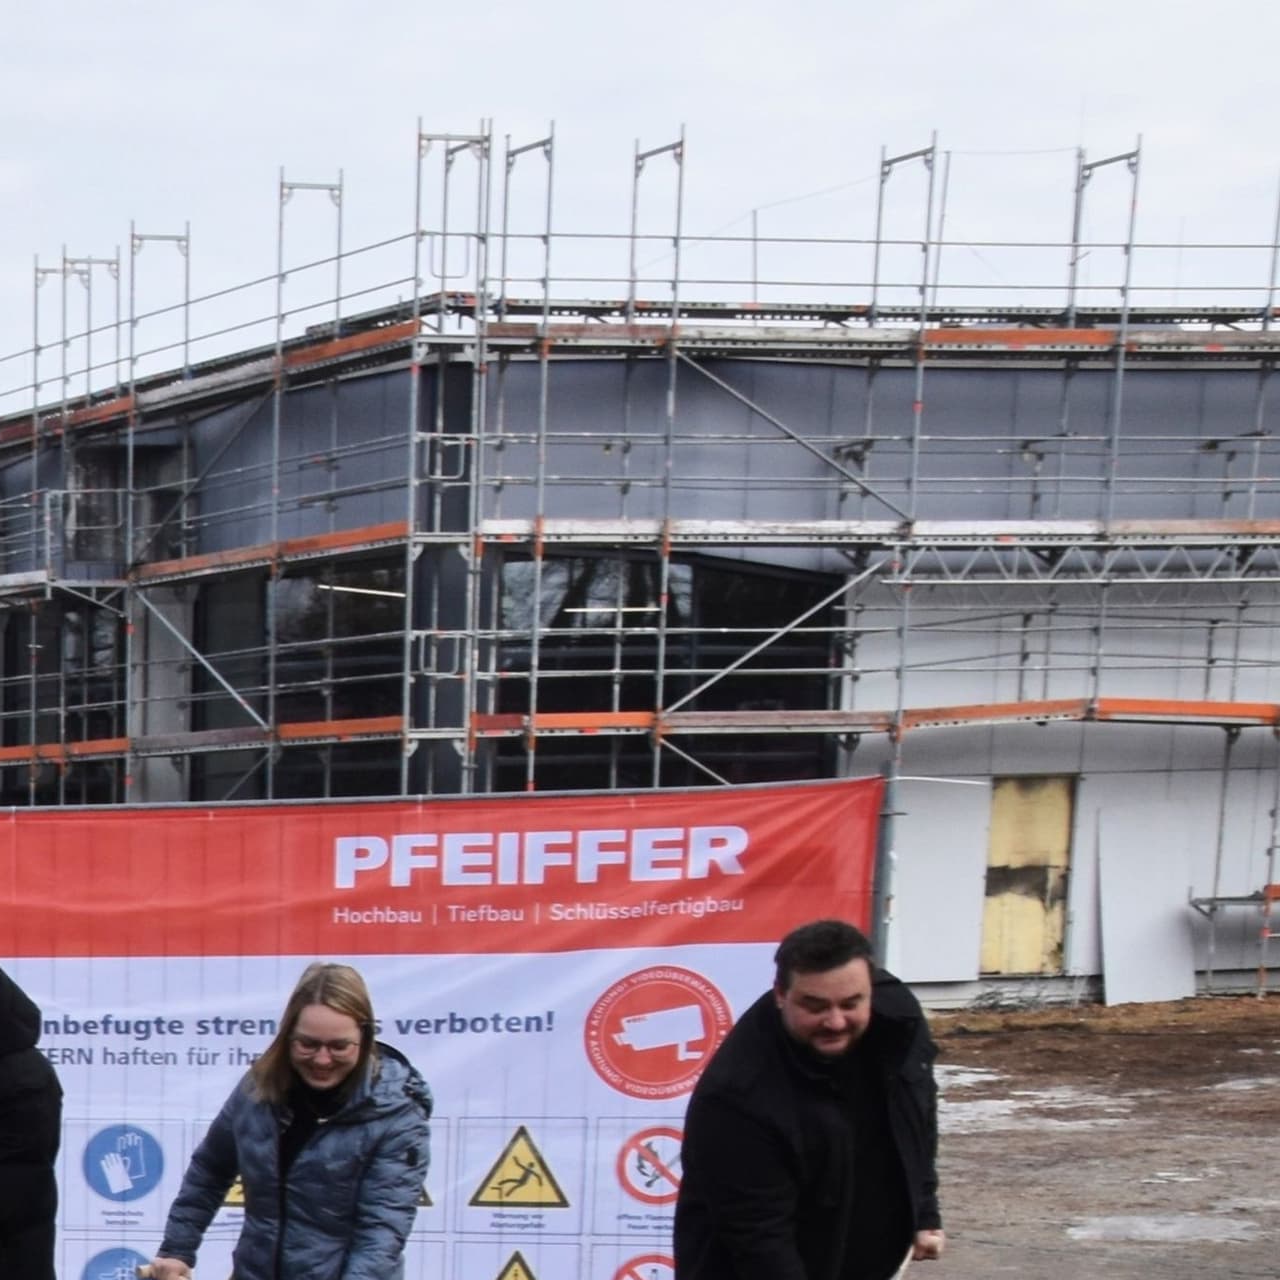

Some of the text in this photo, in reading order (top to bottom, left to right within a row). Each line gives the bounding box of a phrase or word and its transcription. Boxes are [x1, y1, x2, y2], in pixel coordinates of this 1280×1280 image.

[334, 825, 748, 889] PFEIFFER
[332, 897, 744, 925] Hochbau Tiefbau Schlüsselfertigbau
[43, 1014, 184, 1041] nbefugte
[395, 1010, 555, 1036] verboten!
[44, 1046, 264, 1066] ERN haften für ihr
